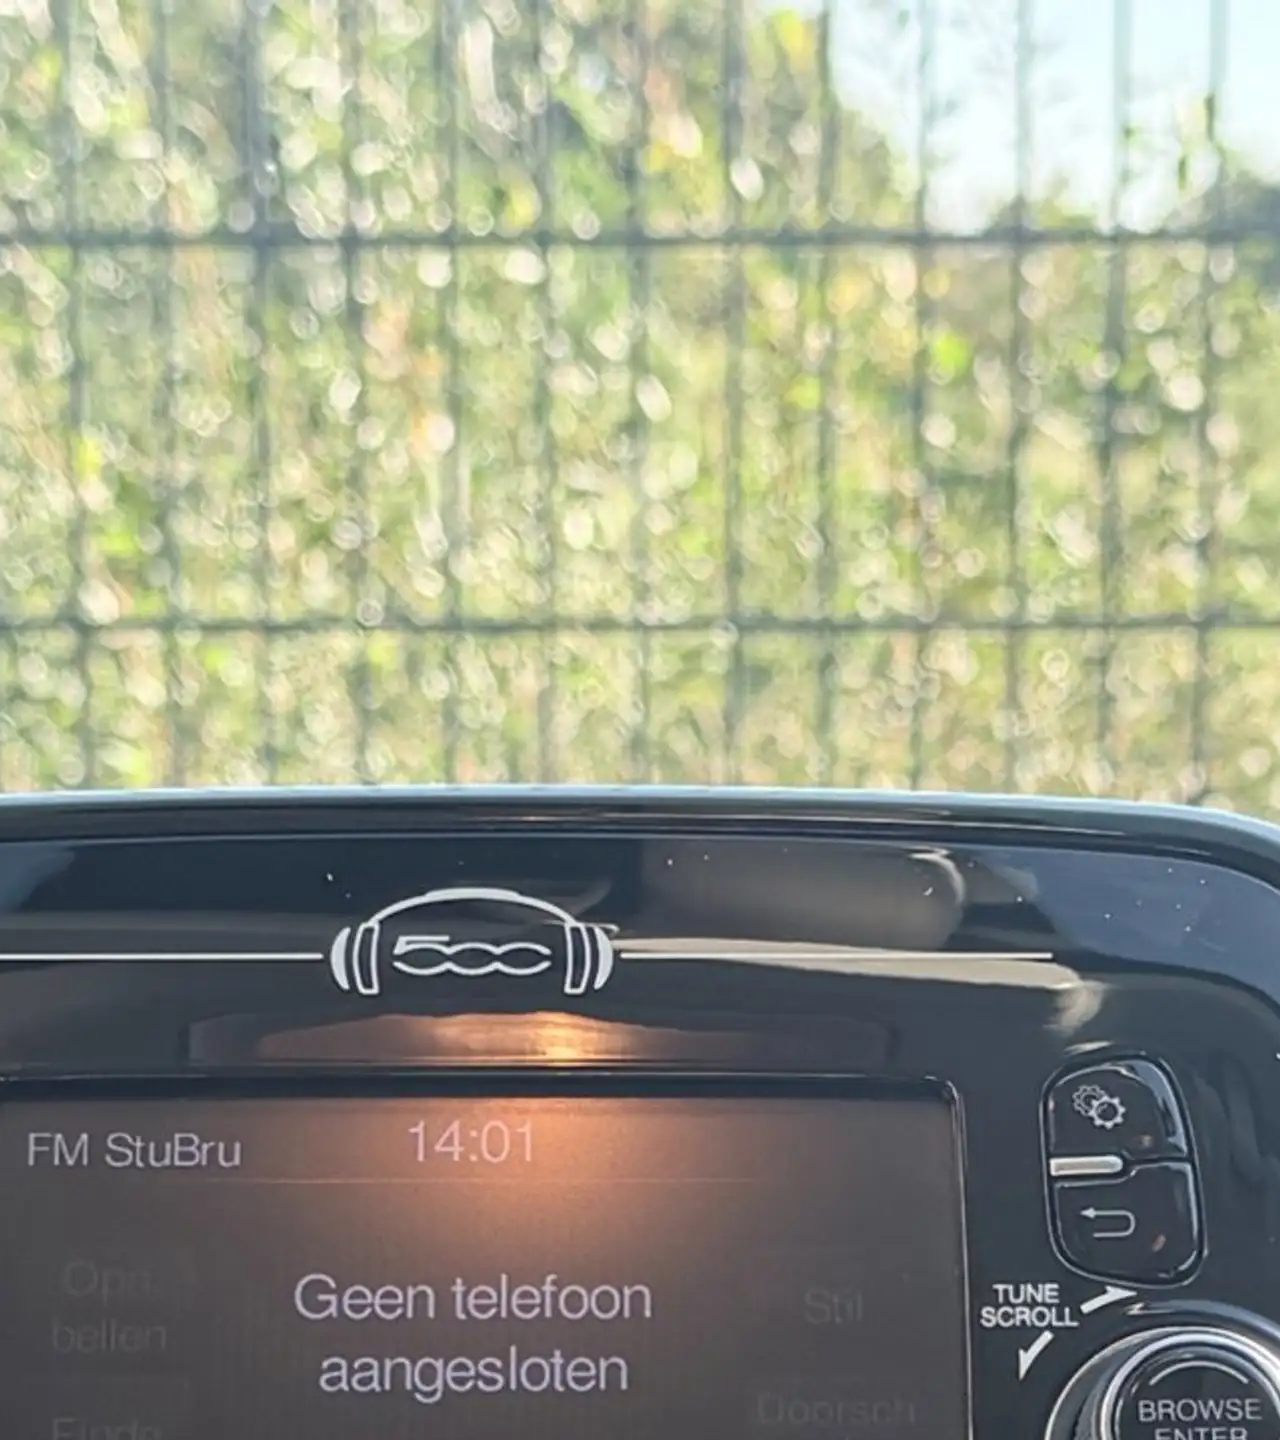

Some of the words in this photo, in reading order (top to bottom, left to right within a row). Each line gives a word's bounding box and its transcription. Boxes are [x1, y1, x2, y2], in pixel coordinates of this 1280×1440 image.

[27, 1131, 89, 1167] FM
[104, 1131, 242, 1168] StuBru
[407, 1119, 533, 1163] 14:01
[294, 1273, 436, 1320] Geen
[452, 1274, 652, 1319] telefoon
[993, 1284, 1060, 1304] TUNE
[980, 1307, 1079, 1328] SCROLL
[319, 1345, 629, 1403] aangesloten
[1138, 1399, 1263, 1424] BROWSE
